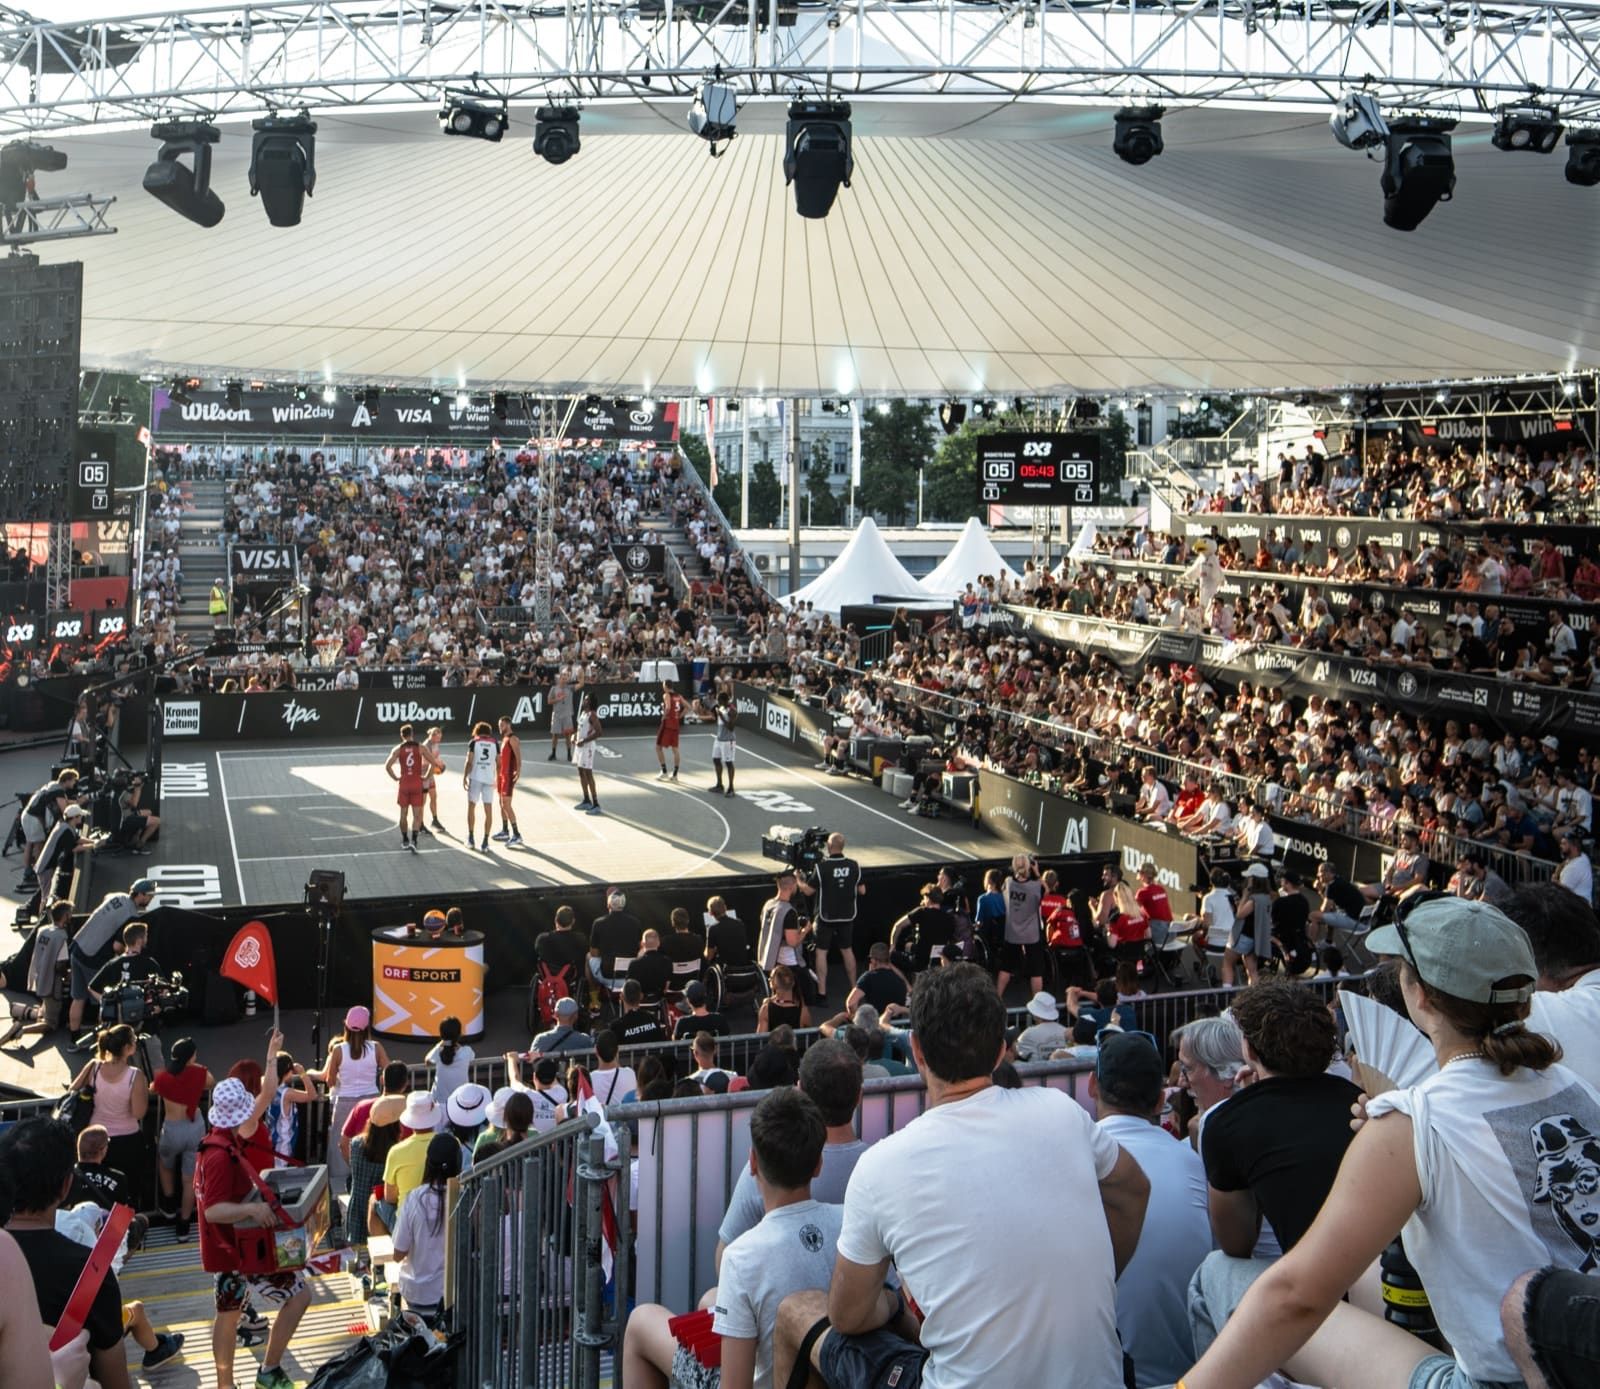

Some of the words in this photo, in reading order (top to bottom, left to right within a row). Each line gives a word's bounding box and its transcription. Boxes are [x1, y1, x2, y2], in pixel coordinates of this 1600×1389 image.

[181, 402, 254, 421] Wilson
[395, 408, 432, 423] VISA
[466, 403, 489, 413] Stadt
[466, 413, 489, 421] Wien
[1439, 420, 1492, 439] Wilson
[84, 466, 104, 482] 05
[989, 463, 1009, 477] 05
[1020, 465, 1055, 477] 05:43
[1066, 464, 1087, 478] 05
[97, 497, 103, 506] 7
[1300, 529, 1321, 543] VISA
[237, 550, 291, 569] VISA
[1312, 661, 1330, 681] A1
[1350, 668, 1377, 687] VISA
[166, 706, 199, 718] Kronen
[281, 698, 321, 731] tpa
[376, 701, 455, 723] Wilson
[512, 691, 542, 723] A1
[166, 718, 199, 730] Zeitung
[768, 710, 788, 730] ORF
[406, 752, 415, 767] 6
[480, 748, 490, 761] 3
[160, 763, 209, 800] TOUR
[1062, 817, 1089, 854] A1
[384, 967, 409, 979] ORF
[413, 970, 458, 981] SPORT
[625, 1022, 657, 1037] AUSTRIA
